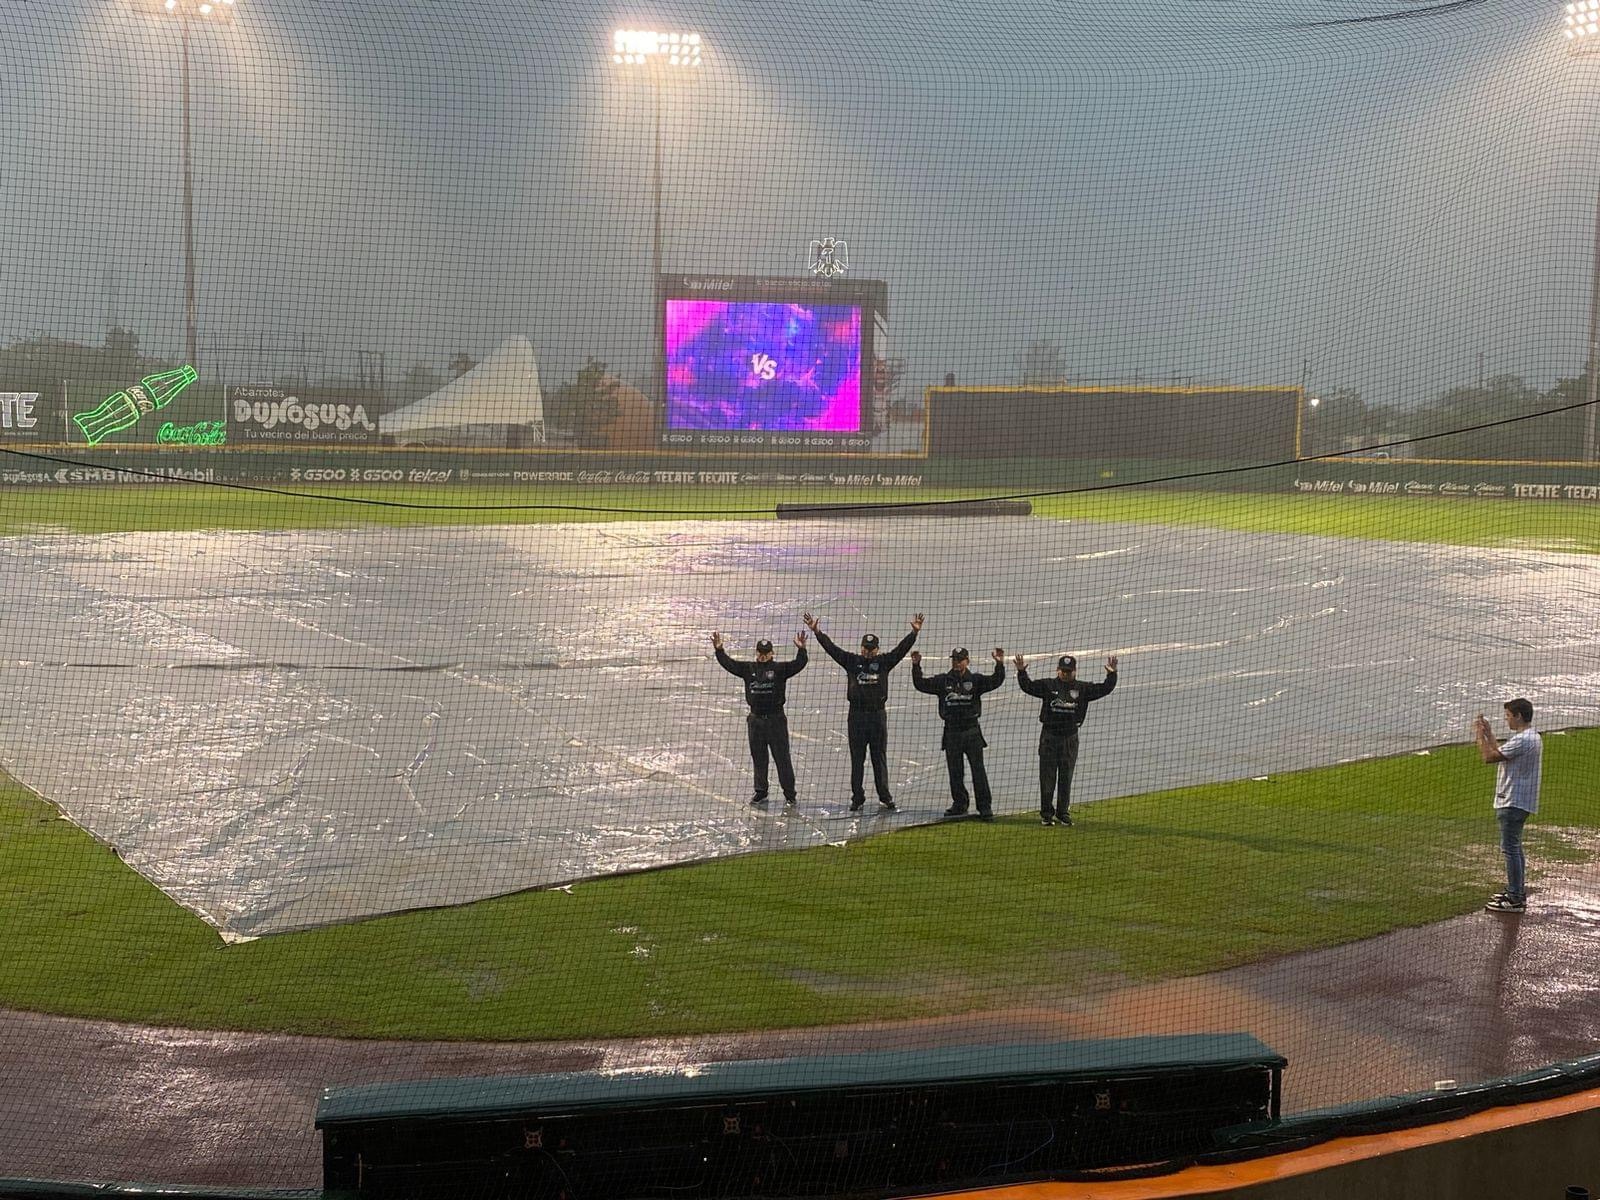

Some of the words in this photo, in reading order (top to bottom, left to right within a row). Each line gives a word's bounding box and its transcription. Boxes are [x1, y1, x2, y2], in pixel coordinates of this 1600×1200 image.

[751, 353, 778, 380] VS
[234, 387, 285, 397] Abarrotes
[260, 430, 291, 439] vecino
[295, 430, 310, 440] del
[312, 431, 337, 441] buen
[339, 432, 367, 442] precio
[118, 468, 164, 483] Mobil
[168, 467, 214, 482] Mobil
[303, 468, 346, 481] G500
[363, 469, 403, 481] G500
[408, 468, 452, 482] telcel
[513, 471, 573, 481] POWERADE
[654, 471, 695, 483] TECATE
[846, 474, 874, 486] Mifel
[894, 474, 922, 487] Mifel
[1314, 480, 1344, 493] Mifel
[1368, 481, 1399, 494] Mifel
[1512, 483, 1561, 498] TECATE
